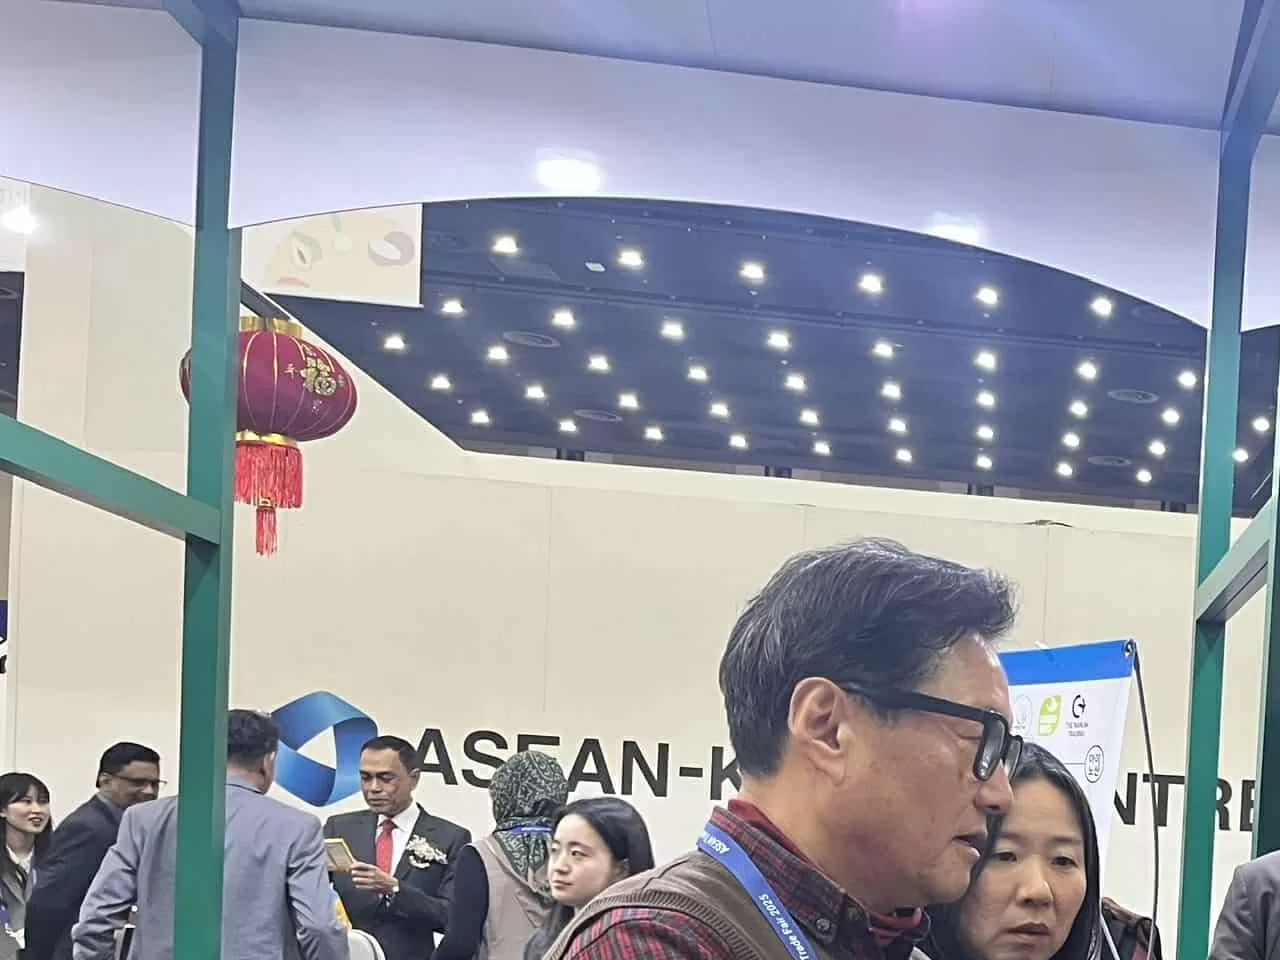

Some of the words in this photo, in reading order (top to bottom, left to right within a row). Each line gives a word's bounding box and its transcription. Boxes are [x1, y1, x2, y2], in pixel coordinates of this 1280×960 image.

[416, 728, 742, 800] ASAN-K
[759, 894, 781, 917] 2025
[776, 916, 793, 936] Fair
